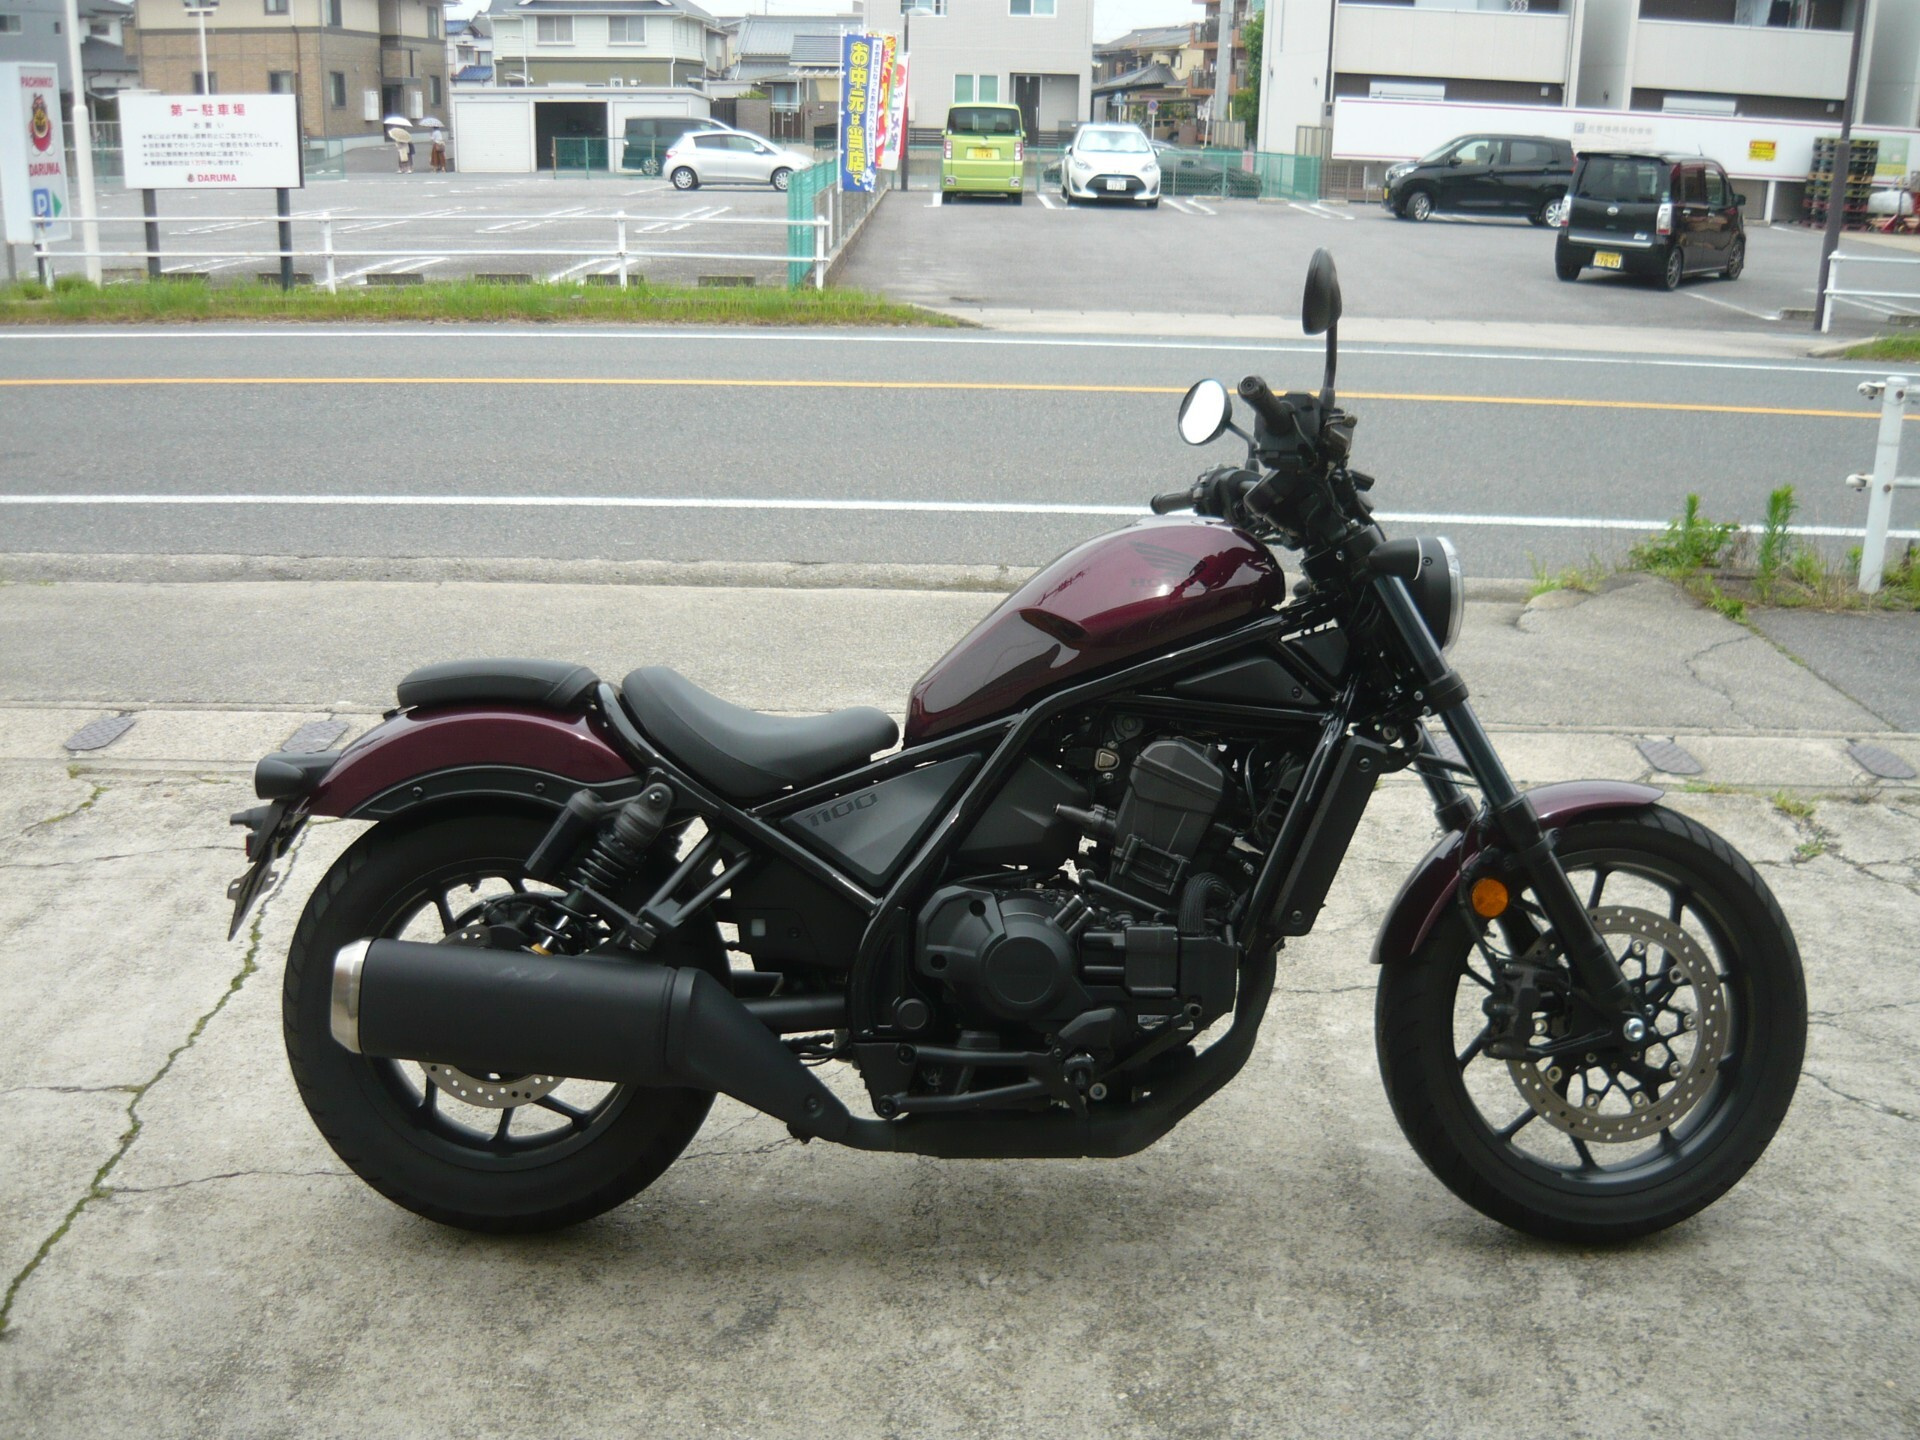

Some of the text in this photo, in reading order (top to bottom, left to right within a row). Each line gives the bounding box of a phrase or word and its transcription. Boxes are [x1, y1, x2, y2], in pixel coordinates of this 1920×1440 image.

[170, 103, 246, 117] 第一駐車場
[846, 41, 869, 186] お中元は当店で
[29, 162, 62, 177] DARUMA
[197, 174, 237, 182] DARUMA
[804, 792, 878, 827] 1100
